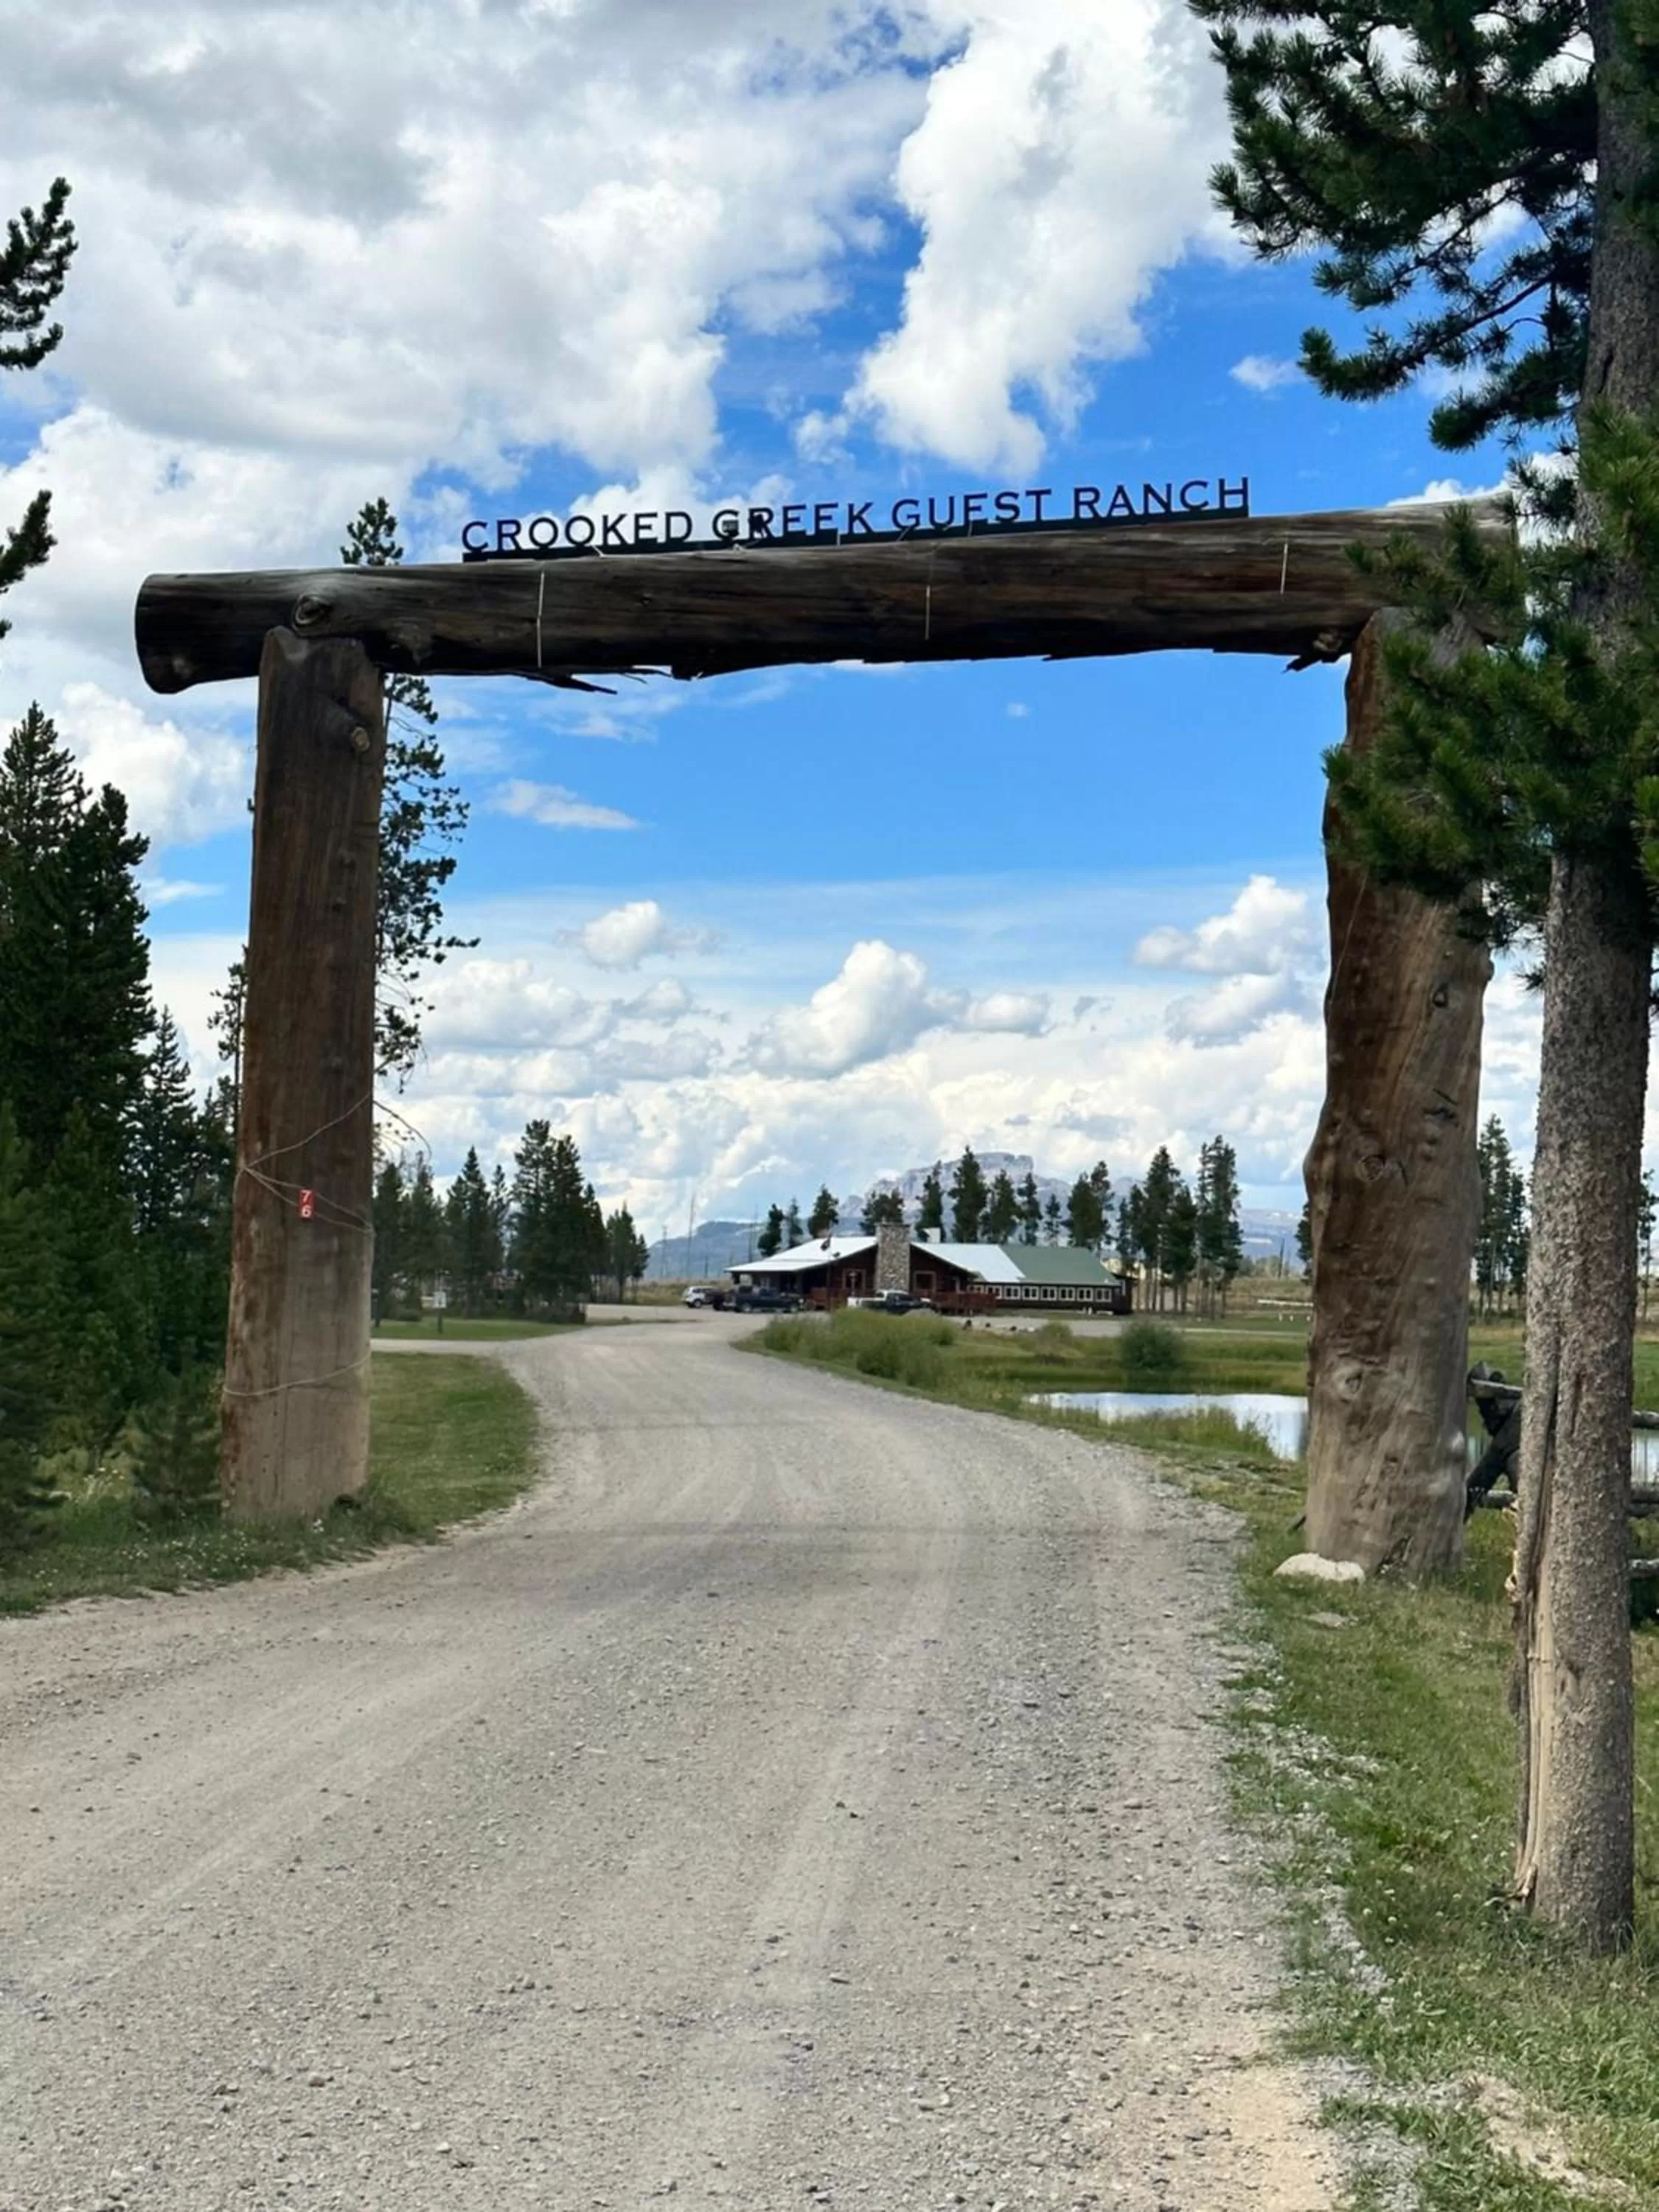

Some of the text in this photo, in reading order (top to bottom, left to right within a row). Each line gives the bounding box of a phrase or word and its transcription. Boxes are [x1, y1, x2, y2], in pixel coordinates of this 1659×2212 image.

[462, 510, 693, 553] CROOKED
[891, 489, 1052, 529] GUEST
[1073, 476, 1250, 518] RANCH
